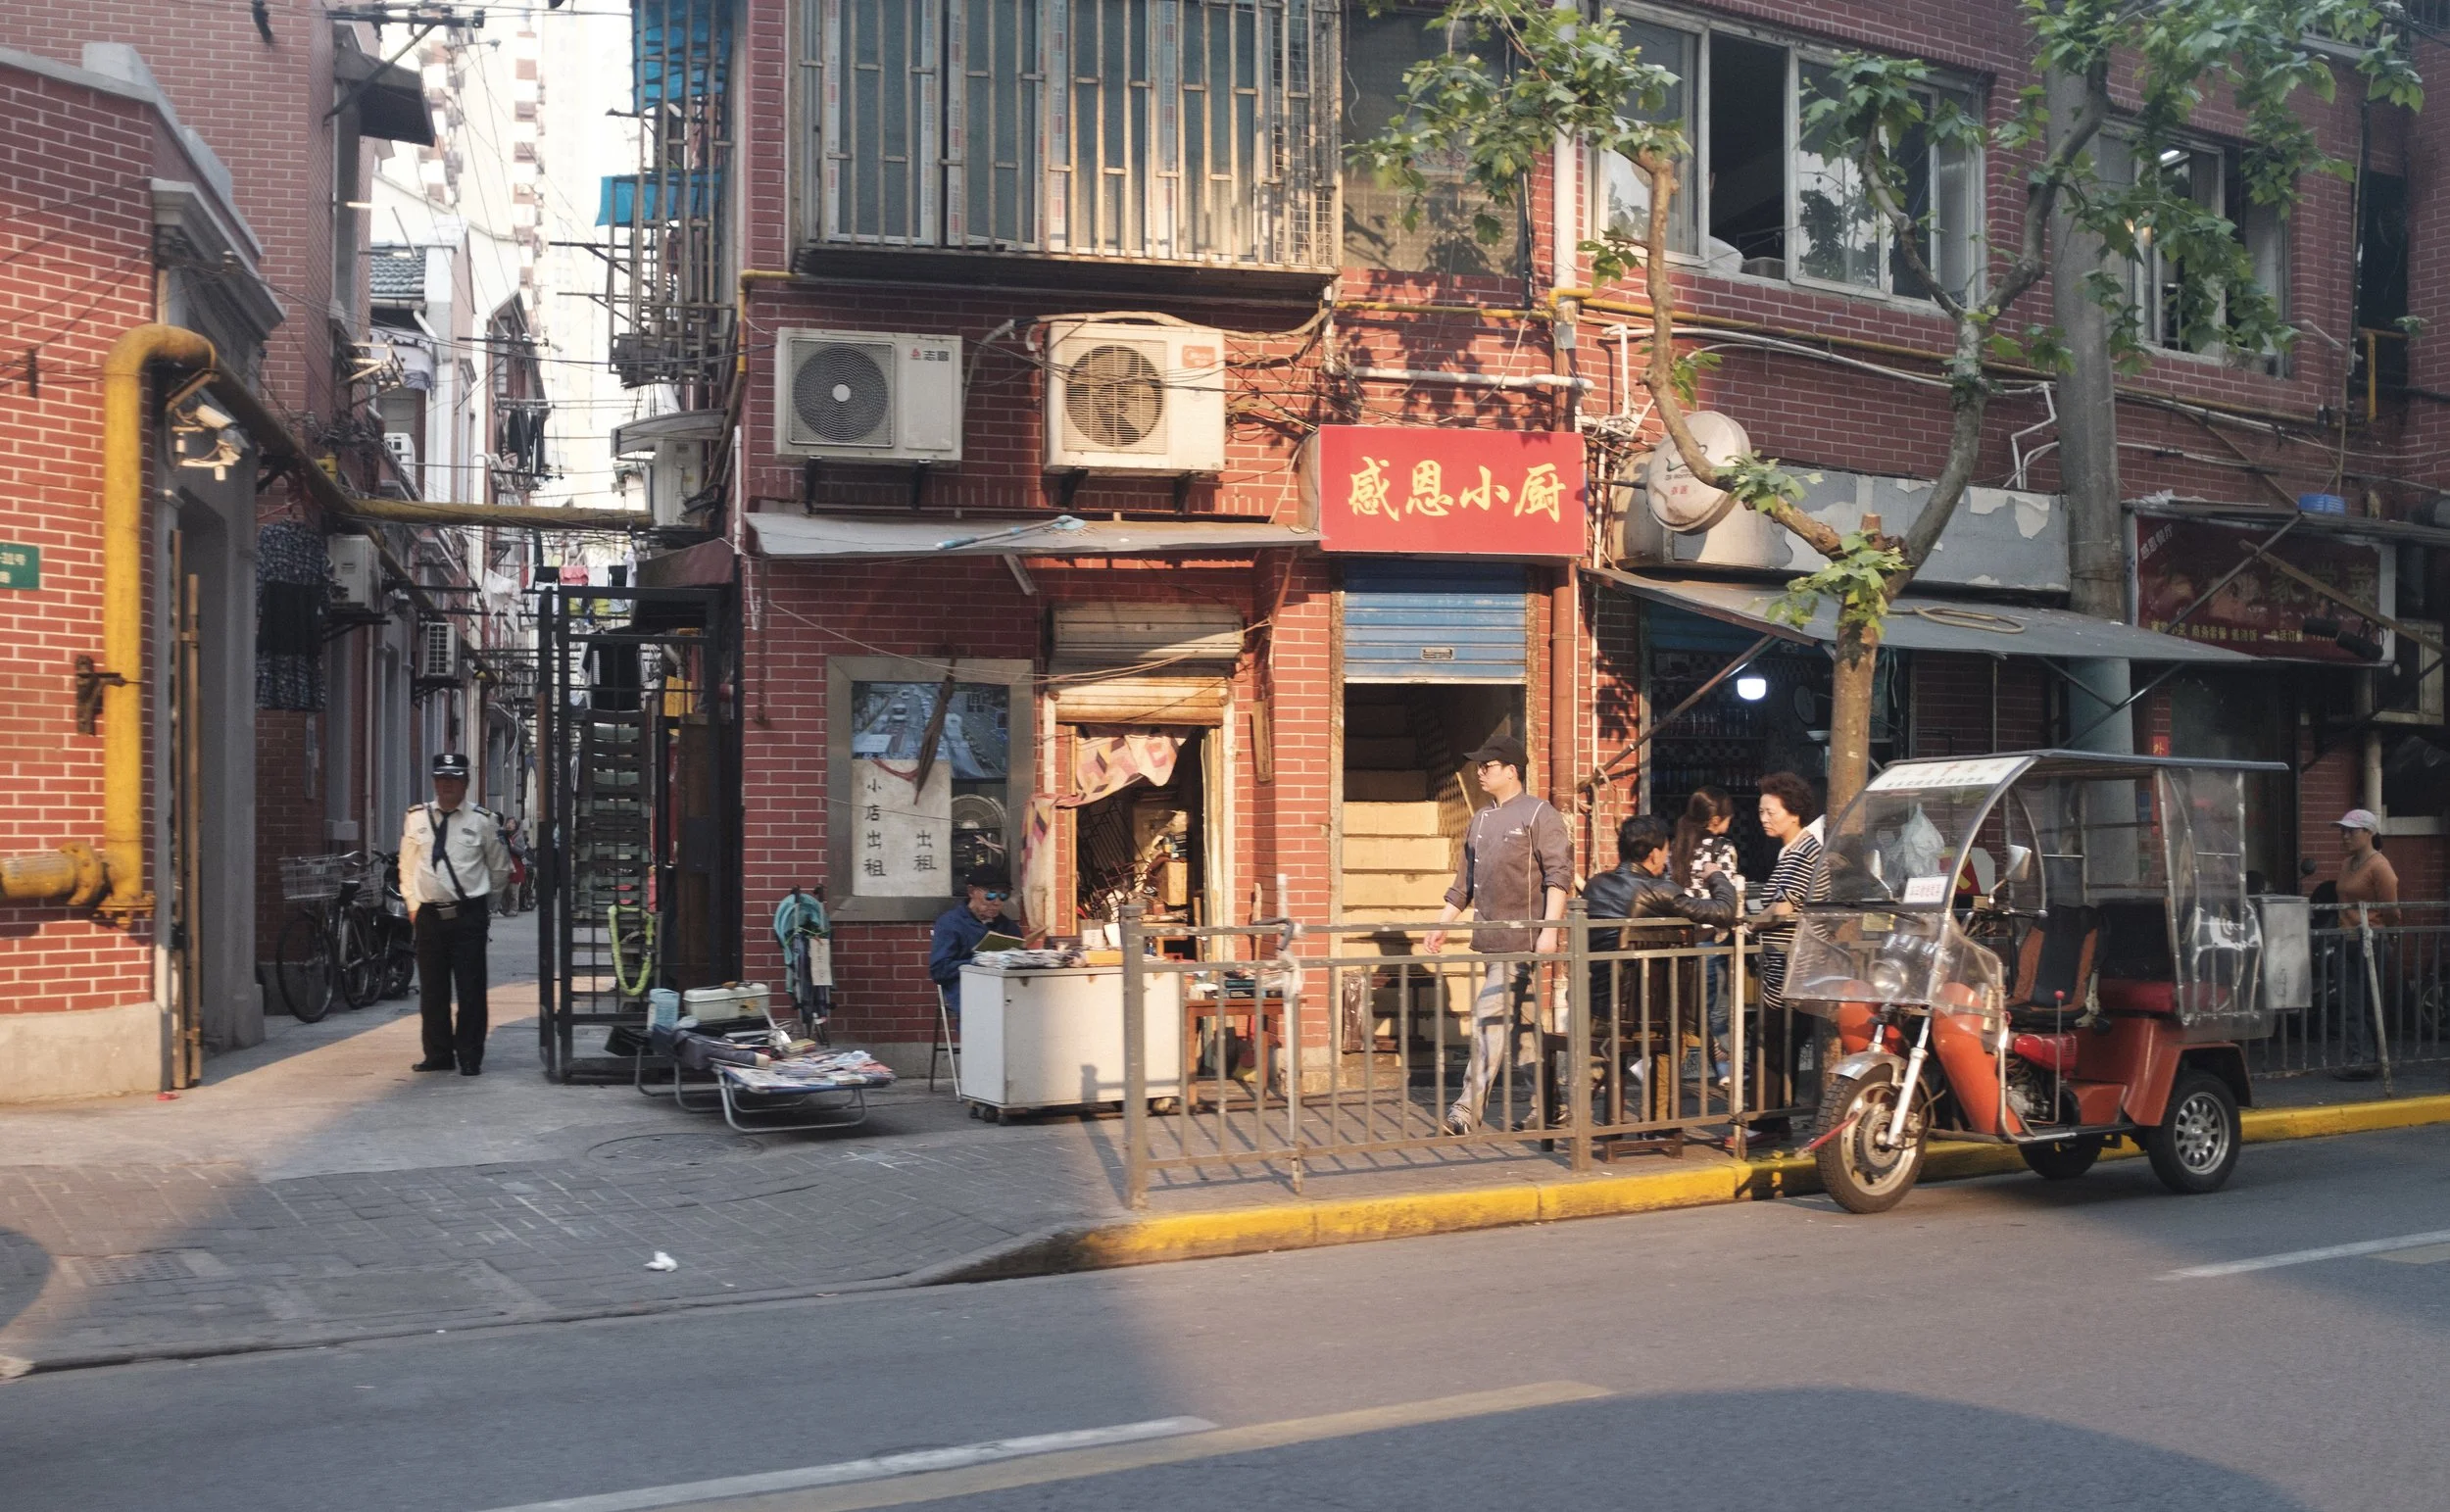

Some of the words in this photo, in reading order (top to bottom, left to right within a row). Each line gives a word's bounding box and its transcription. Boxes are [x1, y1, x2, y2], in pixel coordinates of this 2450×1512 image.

[1348, 456, 1566, 523] 感恩小厨
[864, 778, 886, 877] 小店出租
[913, 829, 937, 872] 出租
